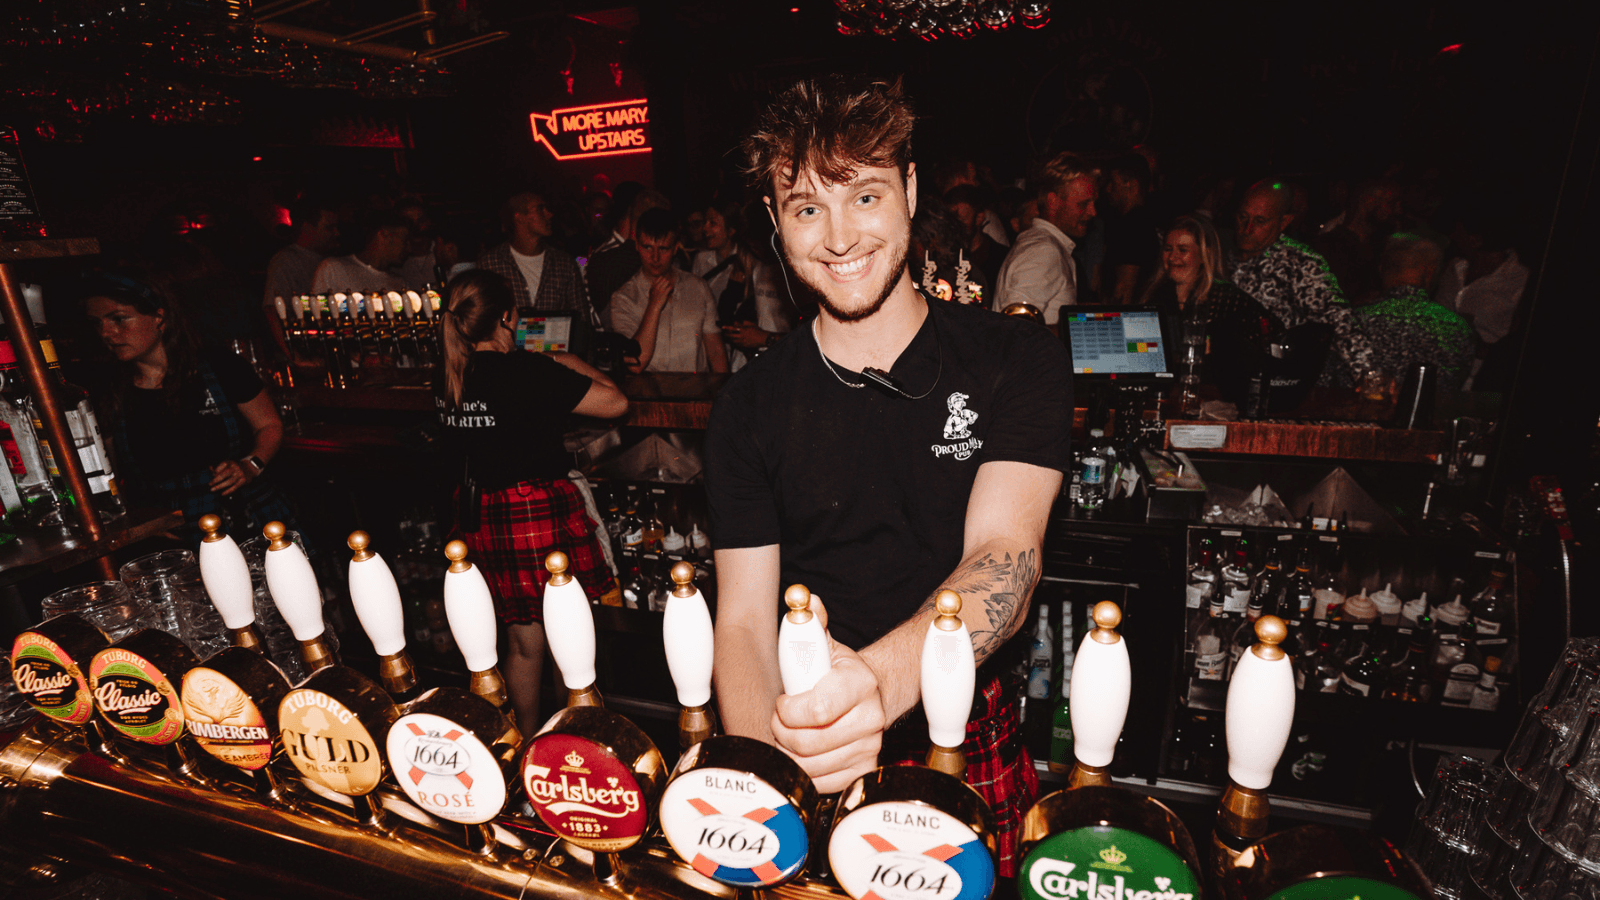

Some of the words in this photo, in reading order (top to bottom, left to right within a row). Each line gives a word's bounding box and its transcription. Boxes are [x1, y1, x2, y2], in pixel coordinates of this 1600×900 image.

[562, 111, 605, 132] MORE
[605, 106, 649, 126] MARY
[578, 128, 646, 151] UPSTAIRS
[931, 441, 969, 458] PROUD
[19, 634, 58, 653] TUBORG
[101, 650, 147, 669] TUBORG
[12, 663, 73, 695] Classic
[94, 681, 162, 713] Classic
[284, 691, 351, 725] TUBORG
[281, 728, 370, 763] GULD
[413, 744, 463, 769] 1664
[305, 762, 351, 775] PILSNER
[524, 764, 640, 815] Carlsberg
[705, 775, 757, 794] BLANC
[417, 790, 475, 808] ROSÉ
[569, 822, 602, 834] 1883
[882, 809, 940, 830] BLANC
[697, 826, 773, 855] 1664
[870, 863, 954, 895] 1664
